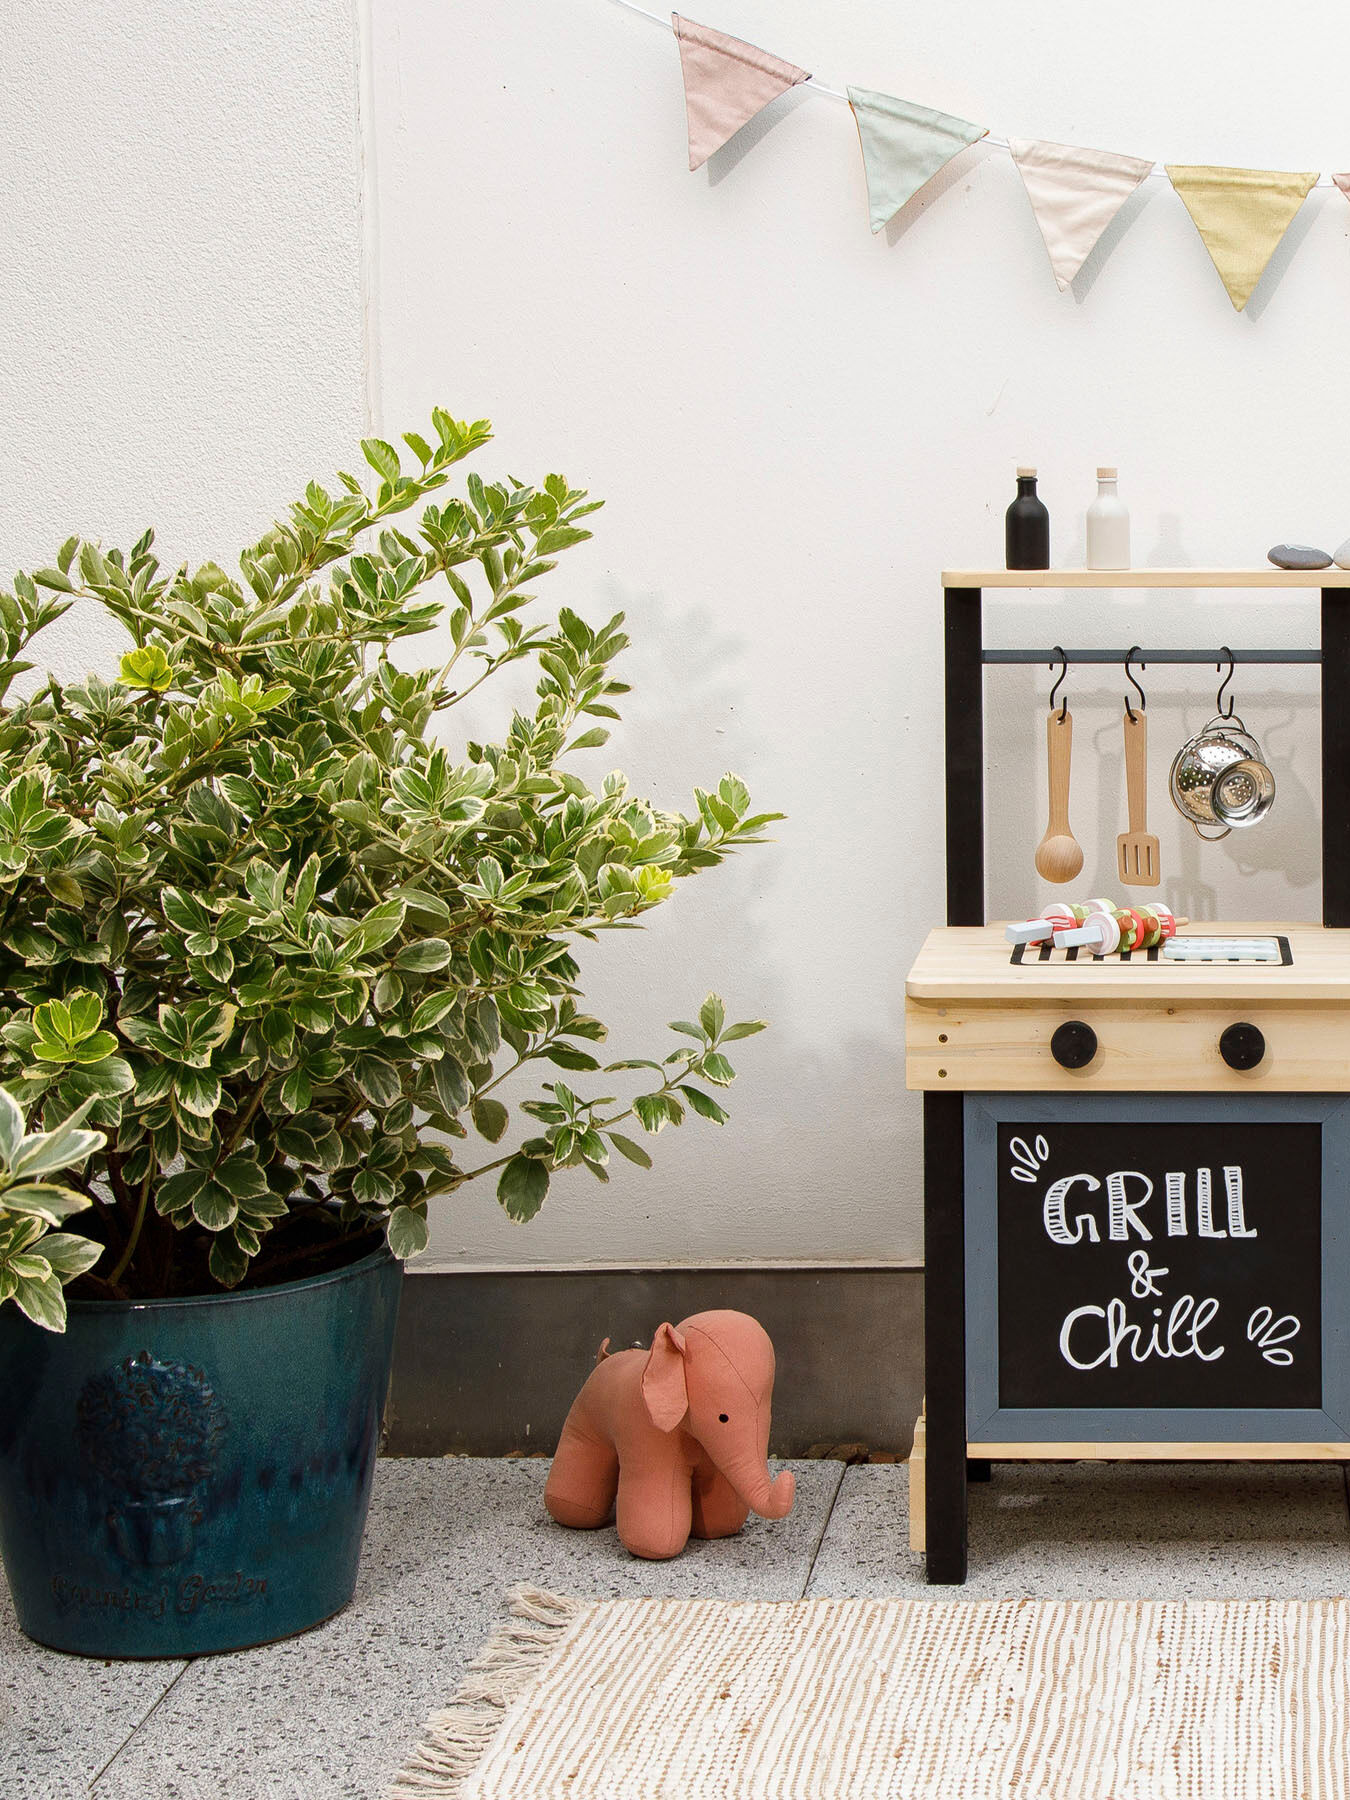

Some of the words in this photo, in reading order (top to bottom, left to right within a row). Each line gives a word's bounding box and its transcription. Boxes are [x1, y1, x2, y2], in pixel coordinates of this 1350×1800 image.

[1044, 1166, 1258, 1244] GRILL
[1128, 1250, 1169, 1298] &
[1060, 1295, 1225, 1369] Chill
